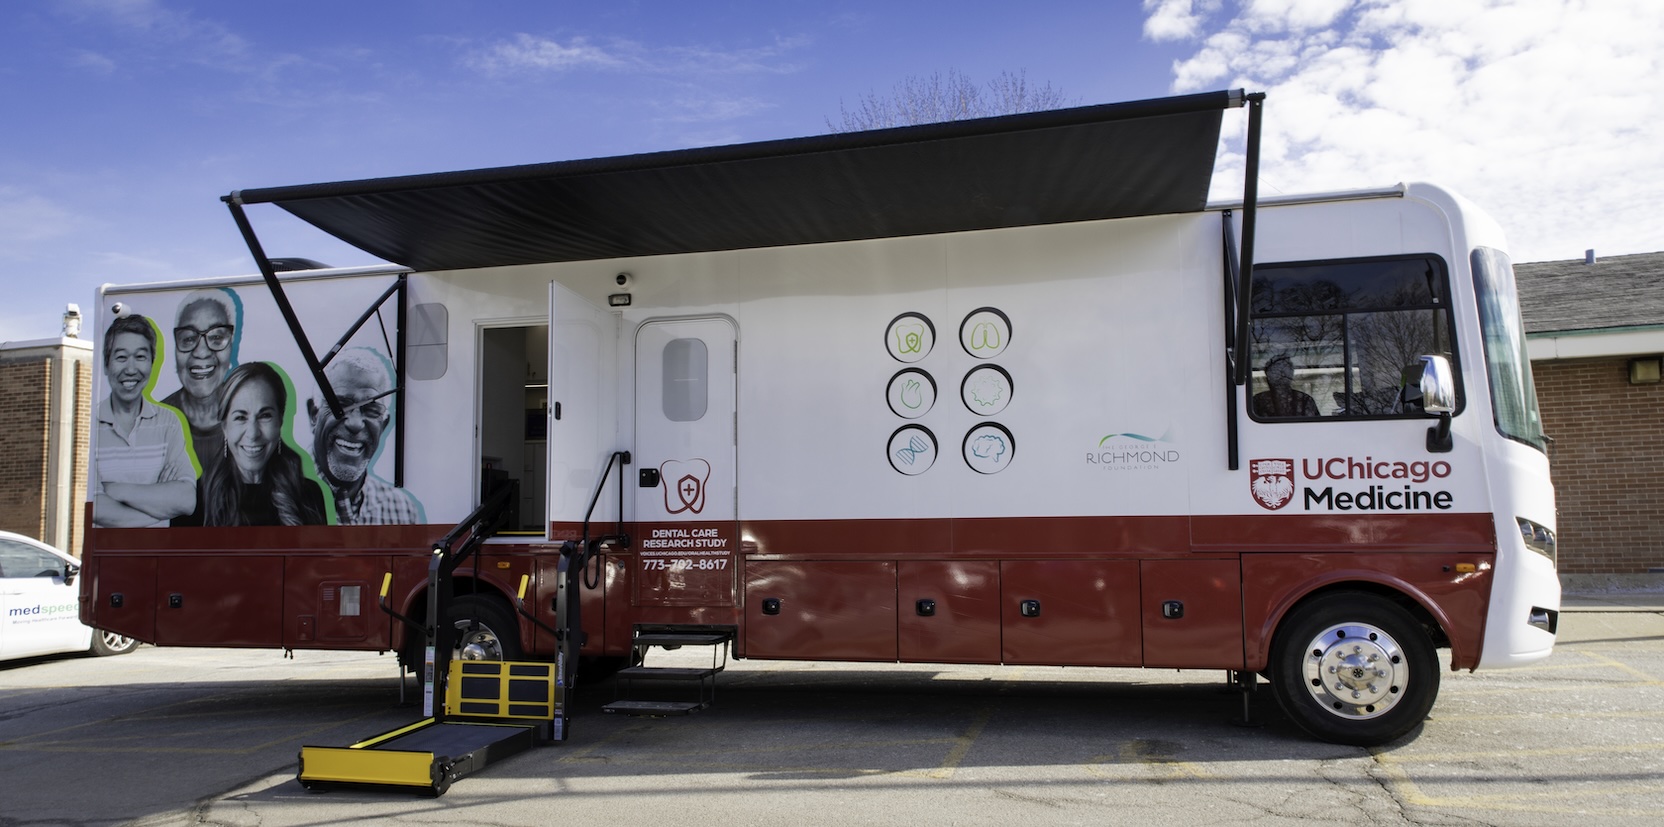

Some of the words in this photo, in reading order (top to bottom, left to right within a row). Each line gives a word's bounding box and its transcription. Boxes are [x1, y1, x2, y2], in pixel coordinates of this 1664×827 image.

[1086, 450, 1180, 464] RICHMOND
[1302, 456, 1452, 483] UChicago
[1303, 485, 1453, 510] Medicine
[652, 529, 690, 538] DENTAL
[691, 529, 718, 537] CARE
[643, 539, 694, 548] RESEARCH
[695, 539, 727, 547] STUDY
